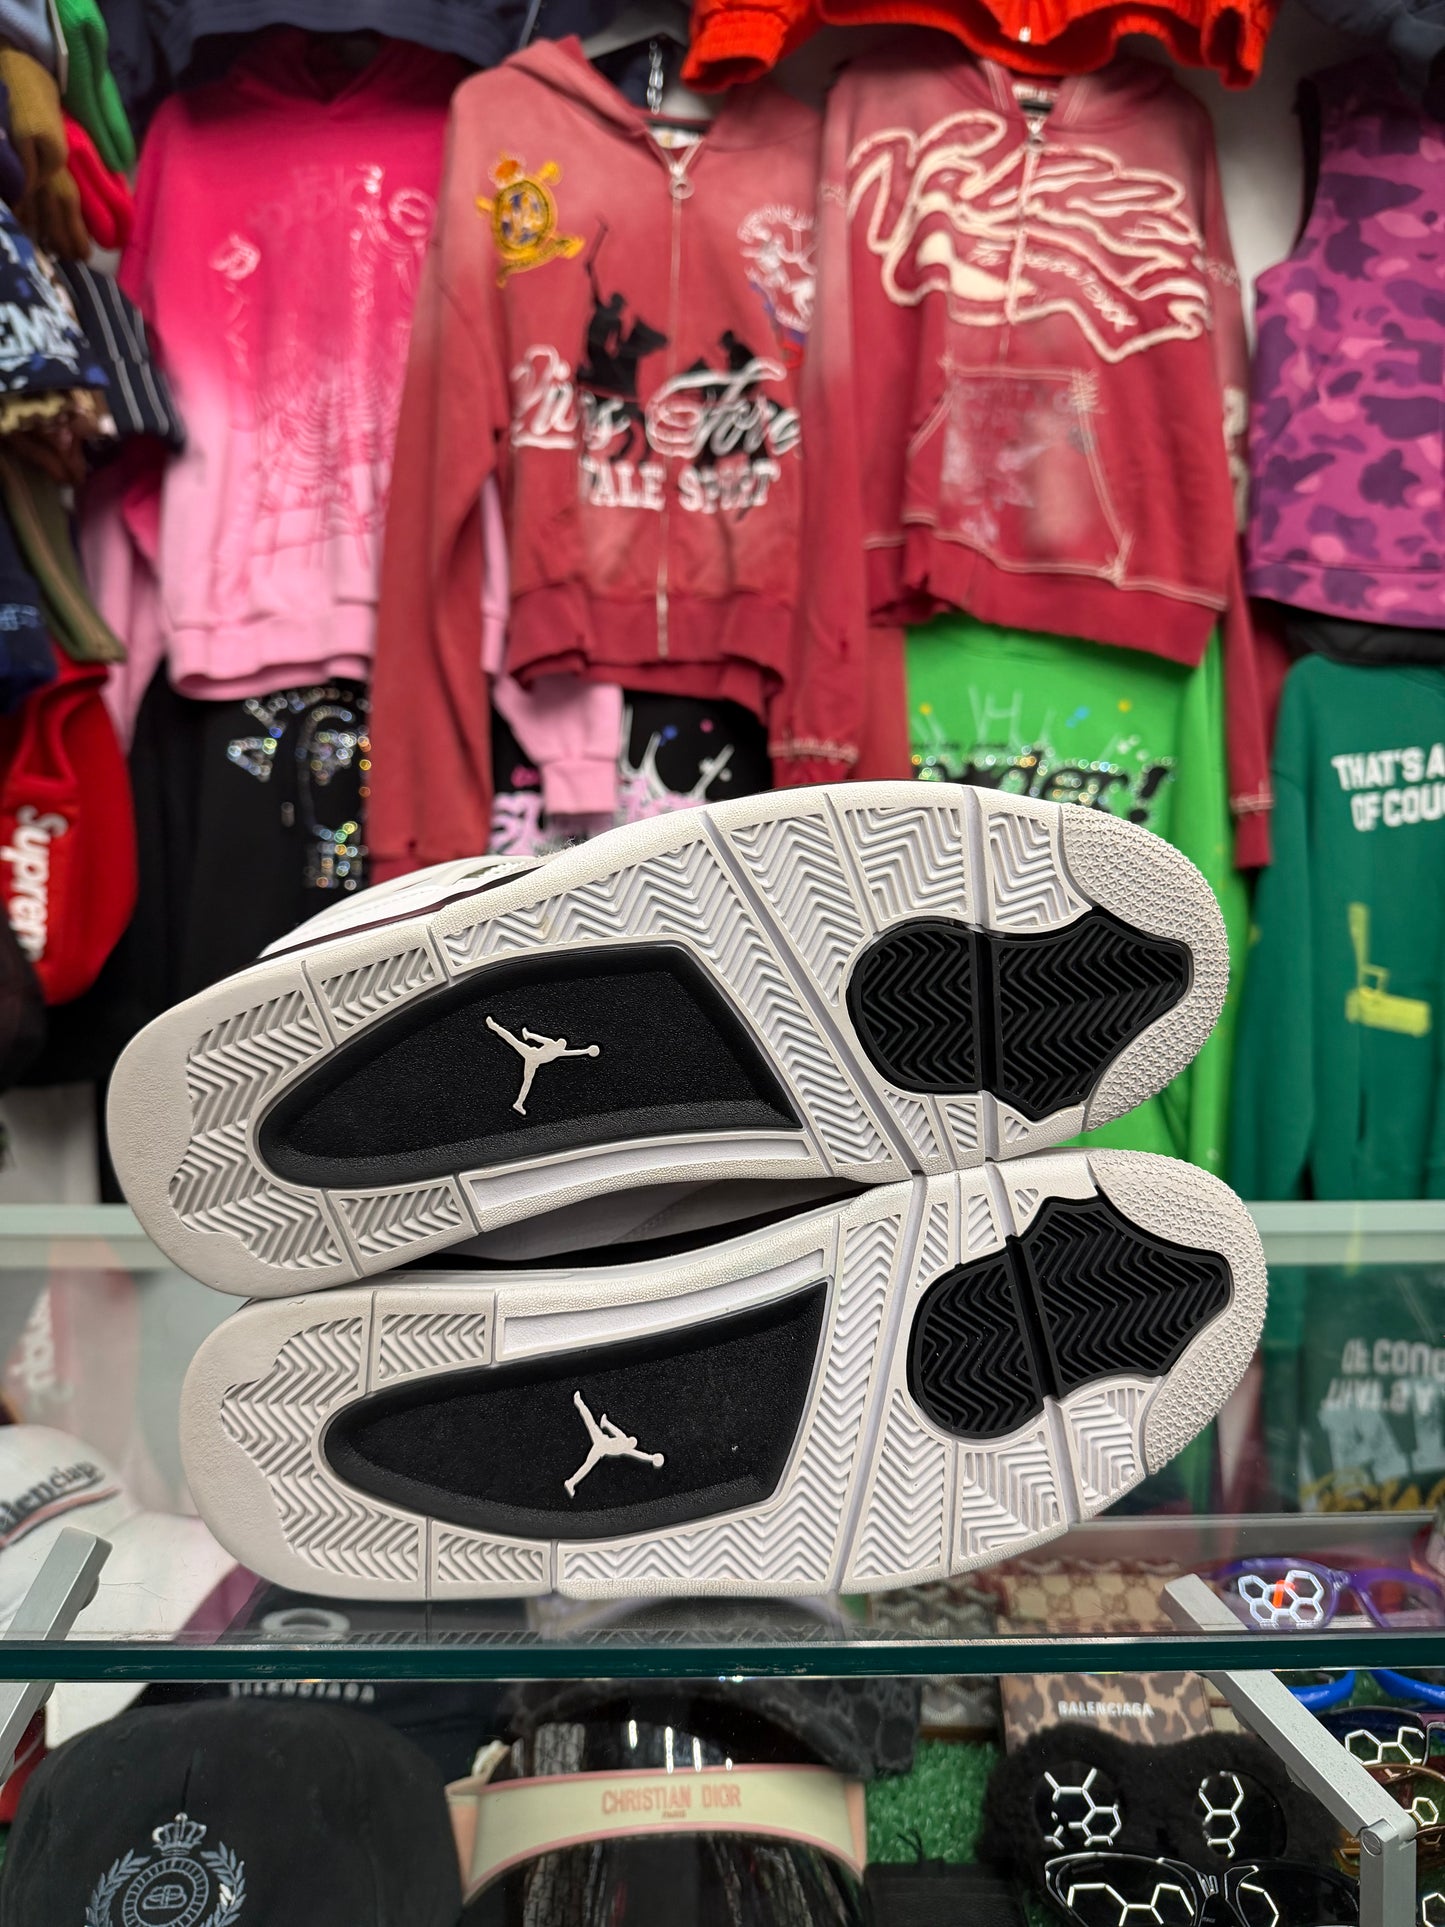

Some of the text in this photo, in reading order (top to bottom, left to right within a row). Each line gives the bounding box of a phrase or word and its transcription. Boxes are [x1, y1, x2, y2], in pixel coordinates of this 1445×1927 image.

[1330, 746, 1425, 791] THAT'S
[1350, 781, 1445, 832] OF COU
[1058, 1700, 1155, 1718] BALENCIAGA
[602, 1783, 742, 1814] CHRISTIAN DIOR
